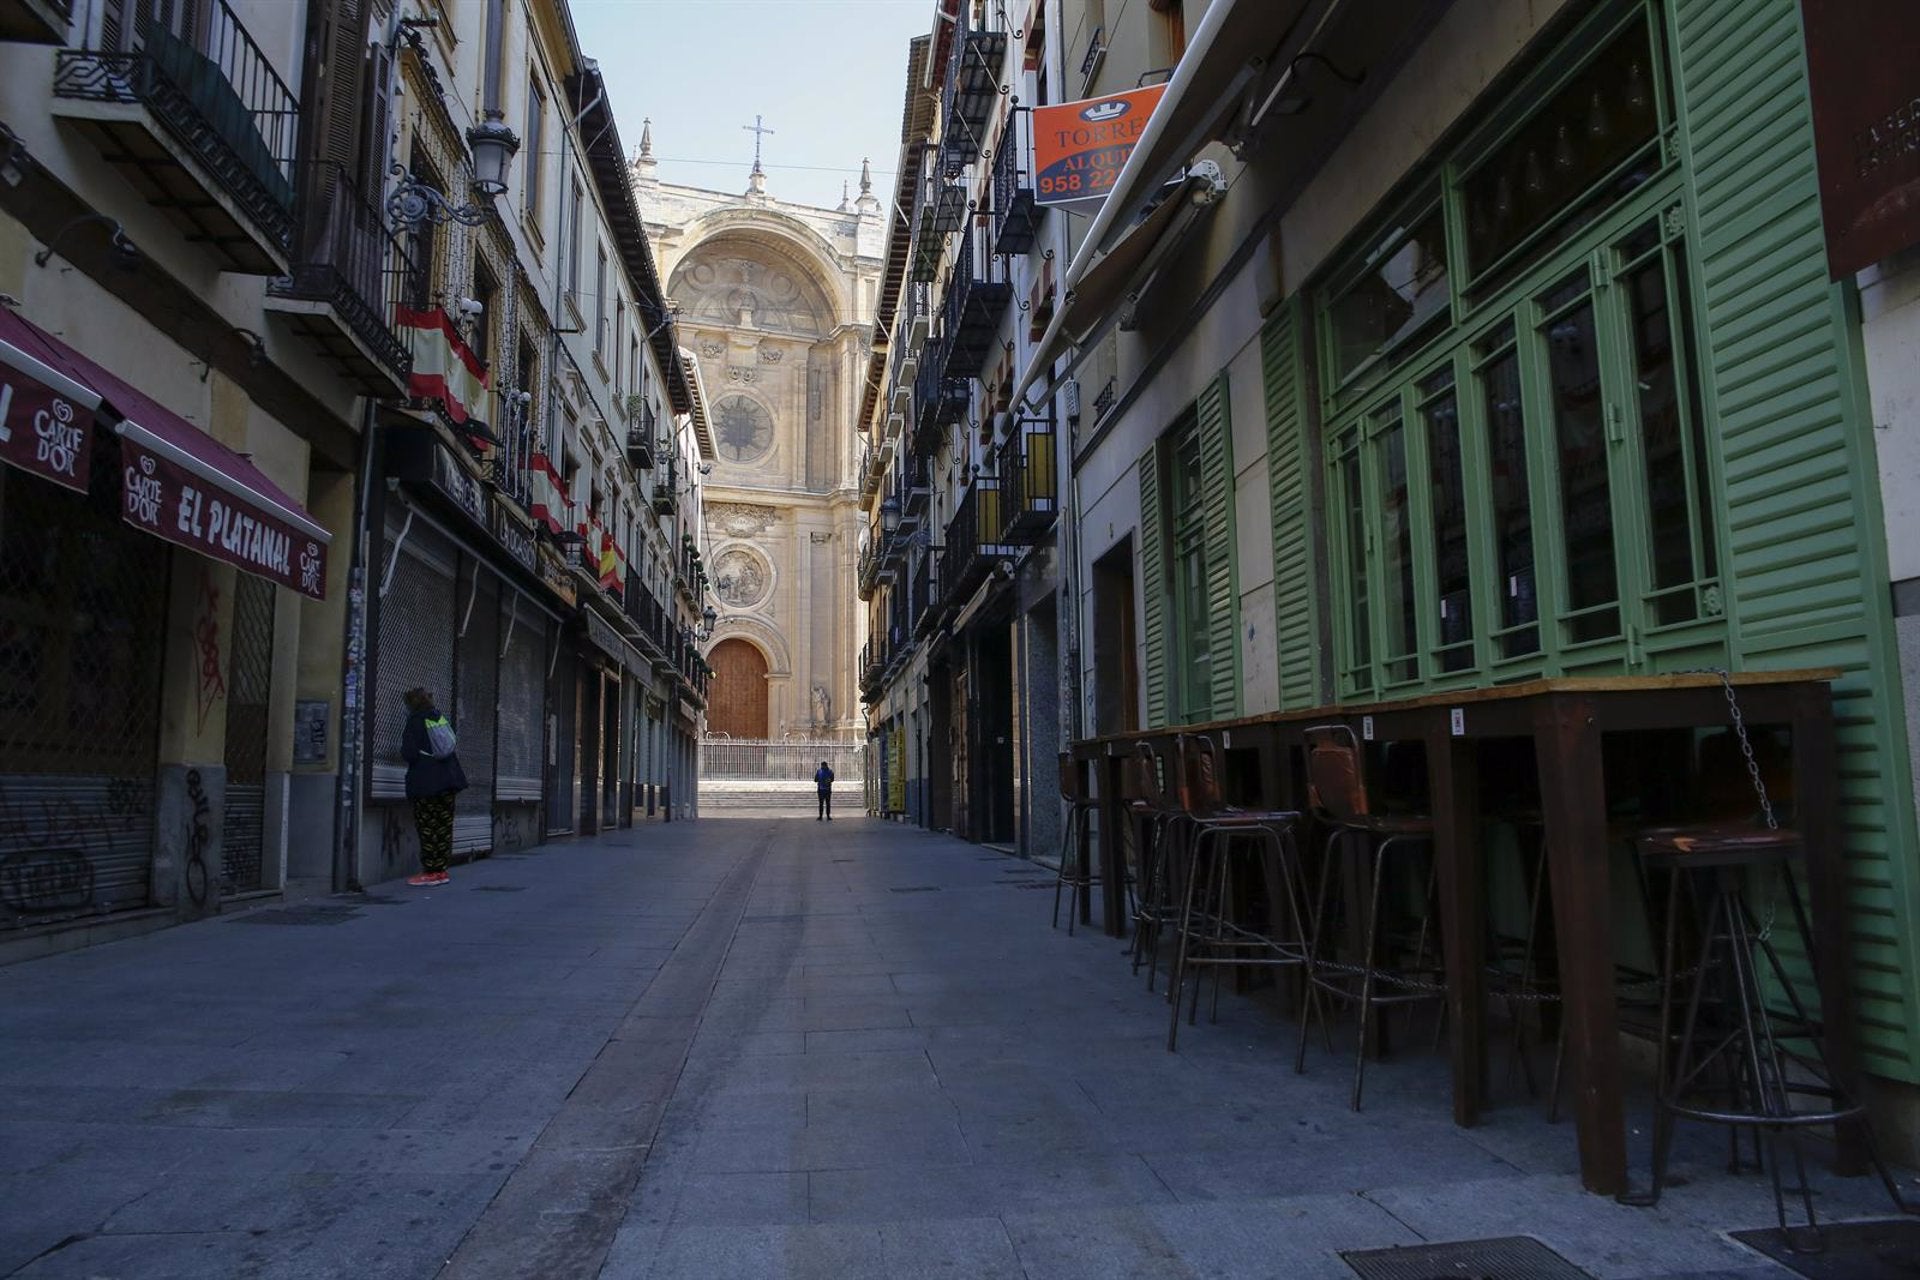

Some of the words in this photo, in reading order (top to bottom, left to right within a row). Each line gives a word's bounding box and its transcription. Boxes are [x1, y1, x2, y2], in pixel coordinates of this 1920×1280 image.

[1056, 115, 1151, 148] TORRE
[1064, 147, 1131, 171] ALQUI
[1040, 174, 1081, 193] 958
[1089, 166, 1122, 188] 22
[35, 409, 83, 452] CARTE
[37, 438, 75, 477] D'OR
[126, 466, 162, 503] CARTE
[178, 485, 202, 538] EL
[208, 500, 290, 576] PLATANAL
